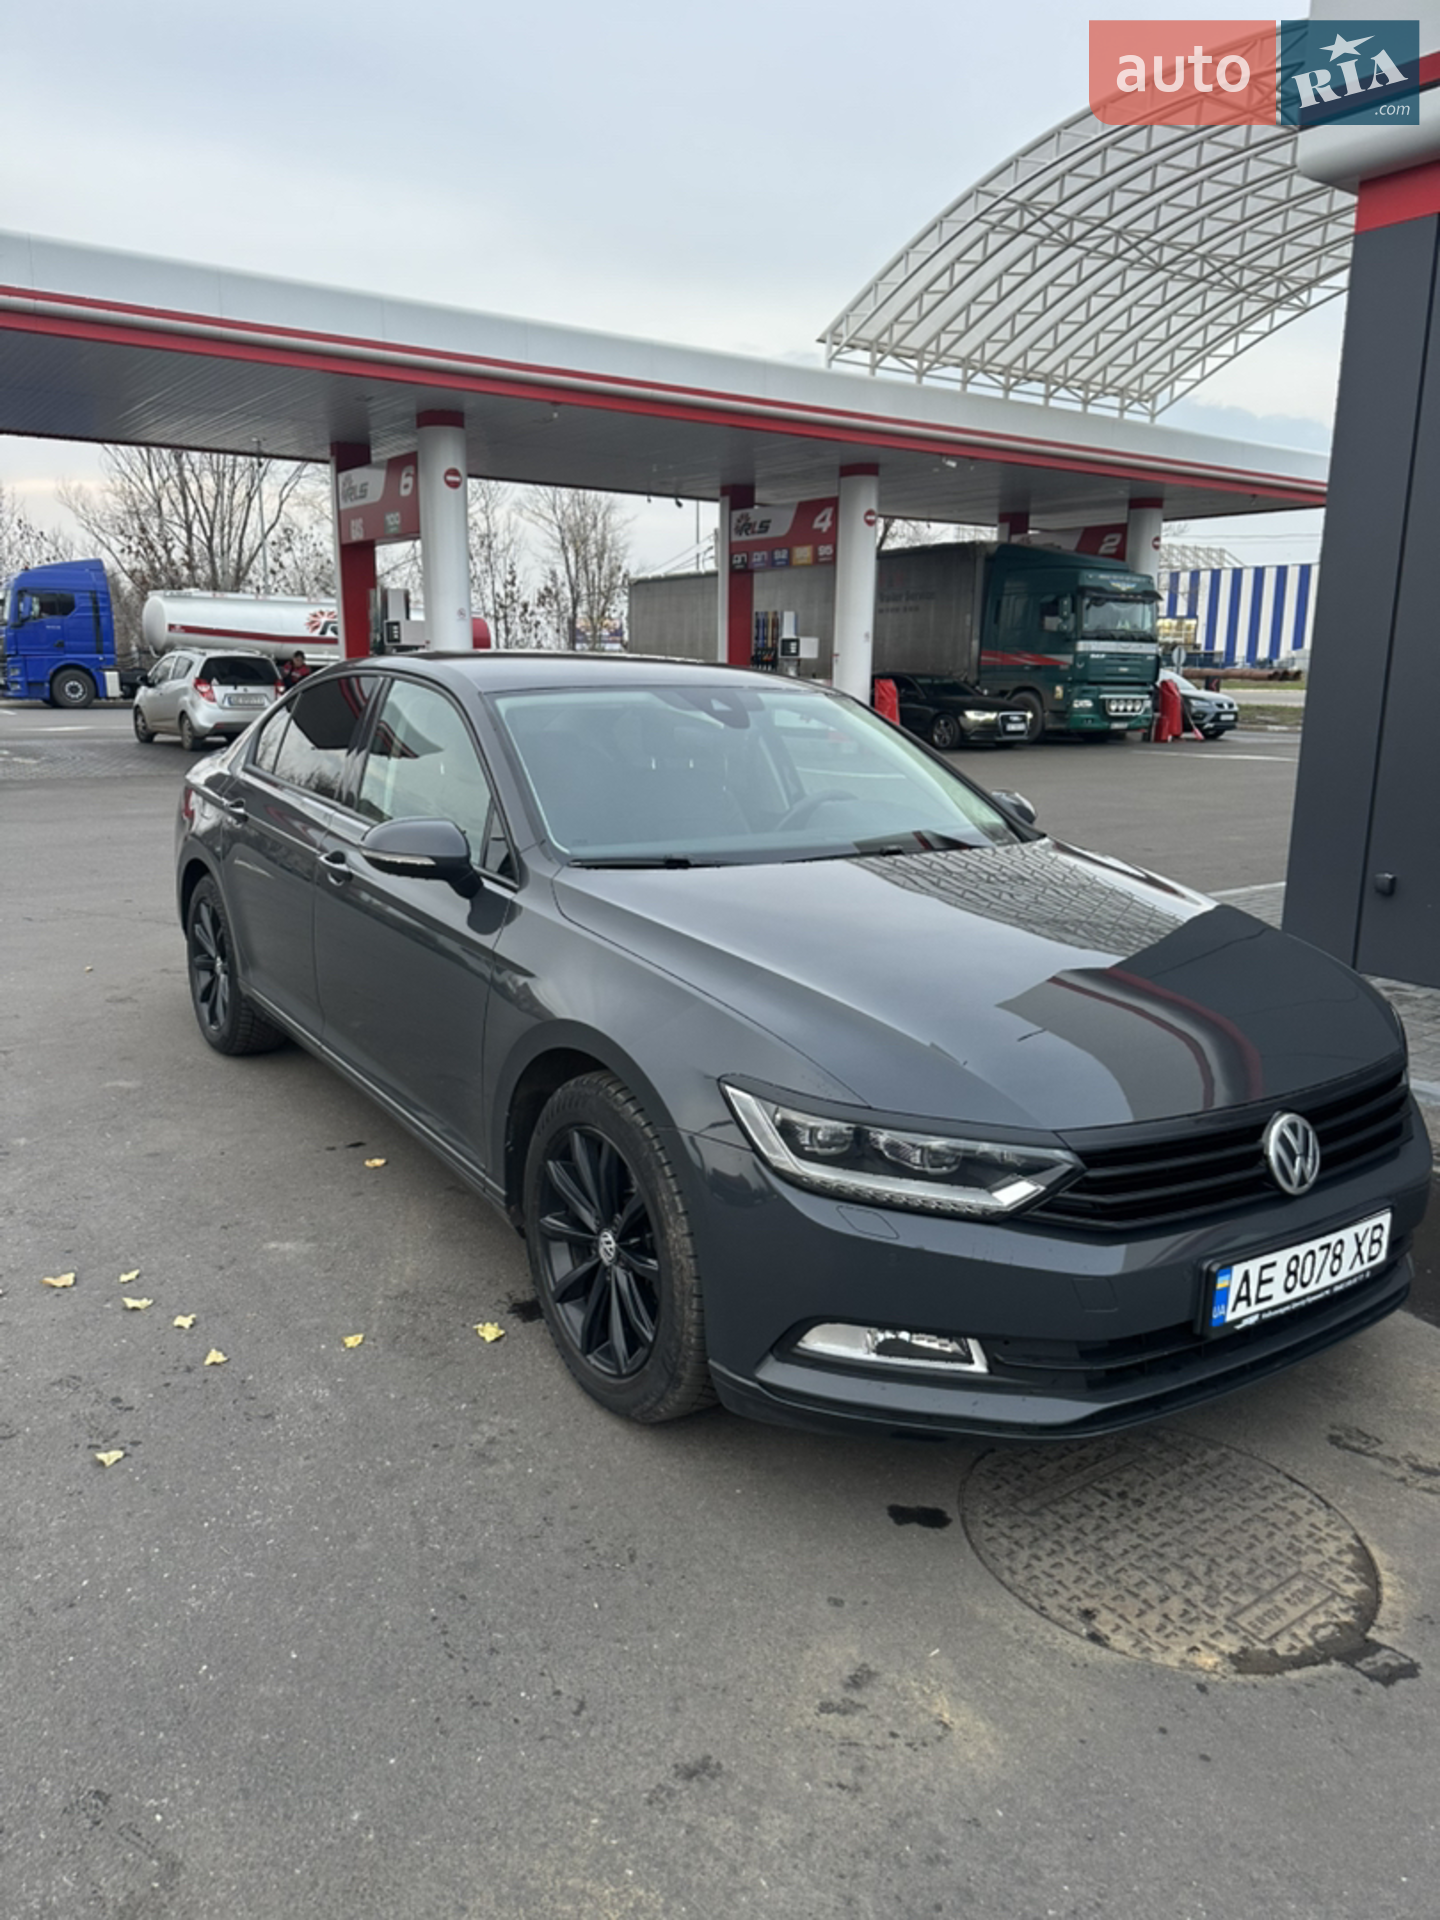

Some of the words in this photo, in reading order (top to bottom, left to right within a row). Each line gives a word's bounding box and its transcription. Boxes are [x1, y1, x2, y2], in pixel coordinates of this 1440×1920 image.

[400, 465, 415, 497] 6
[739, 519, 772, 537] RLS
[812, 507, 834, 534] 4
[1098, 533, 1122, 555] 2
[1231, 1261, 1277, 1313] AE
[1283, 1239, 1345, 1294] 8078
[1349, 1222, 1384, 1271] XB
[1212, 1304, 1226, 1319] UA
